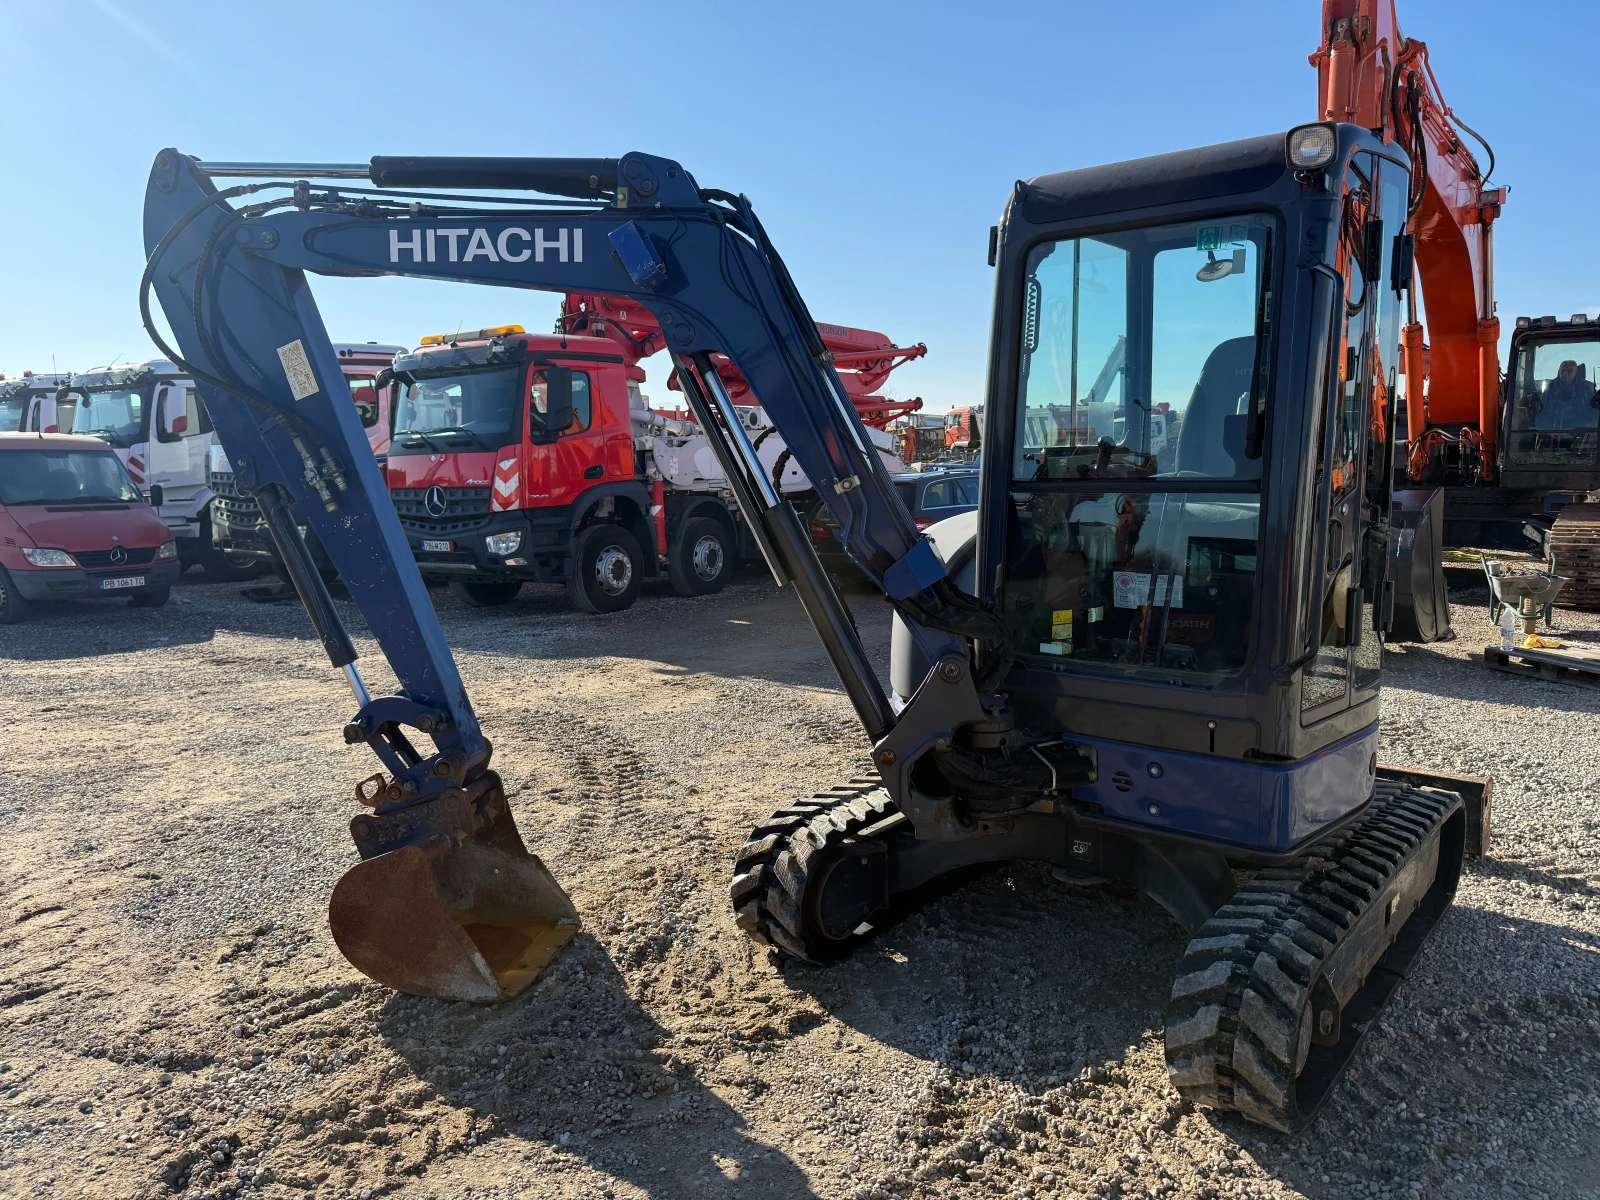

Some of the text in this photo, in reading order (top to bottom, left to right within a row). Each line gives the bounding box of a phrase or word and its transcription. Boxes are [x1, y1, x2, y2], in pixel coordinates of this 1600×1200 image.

[389, 227, 583, 262] HITACHI
[105, 577, 144, 588] PB 1061 TC
